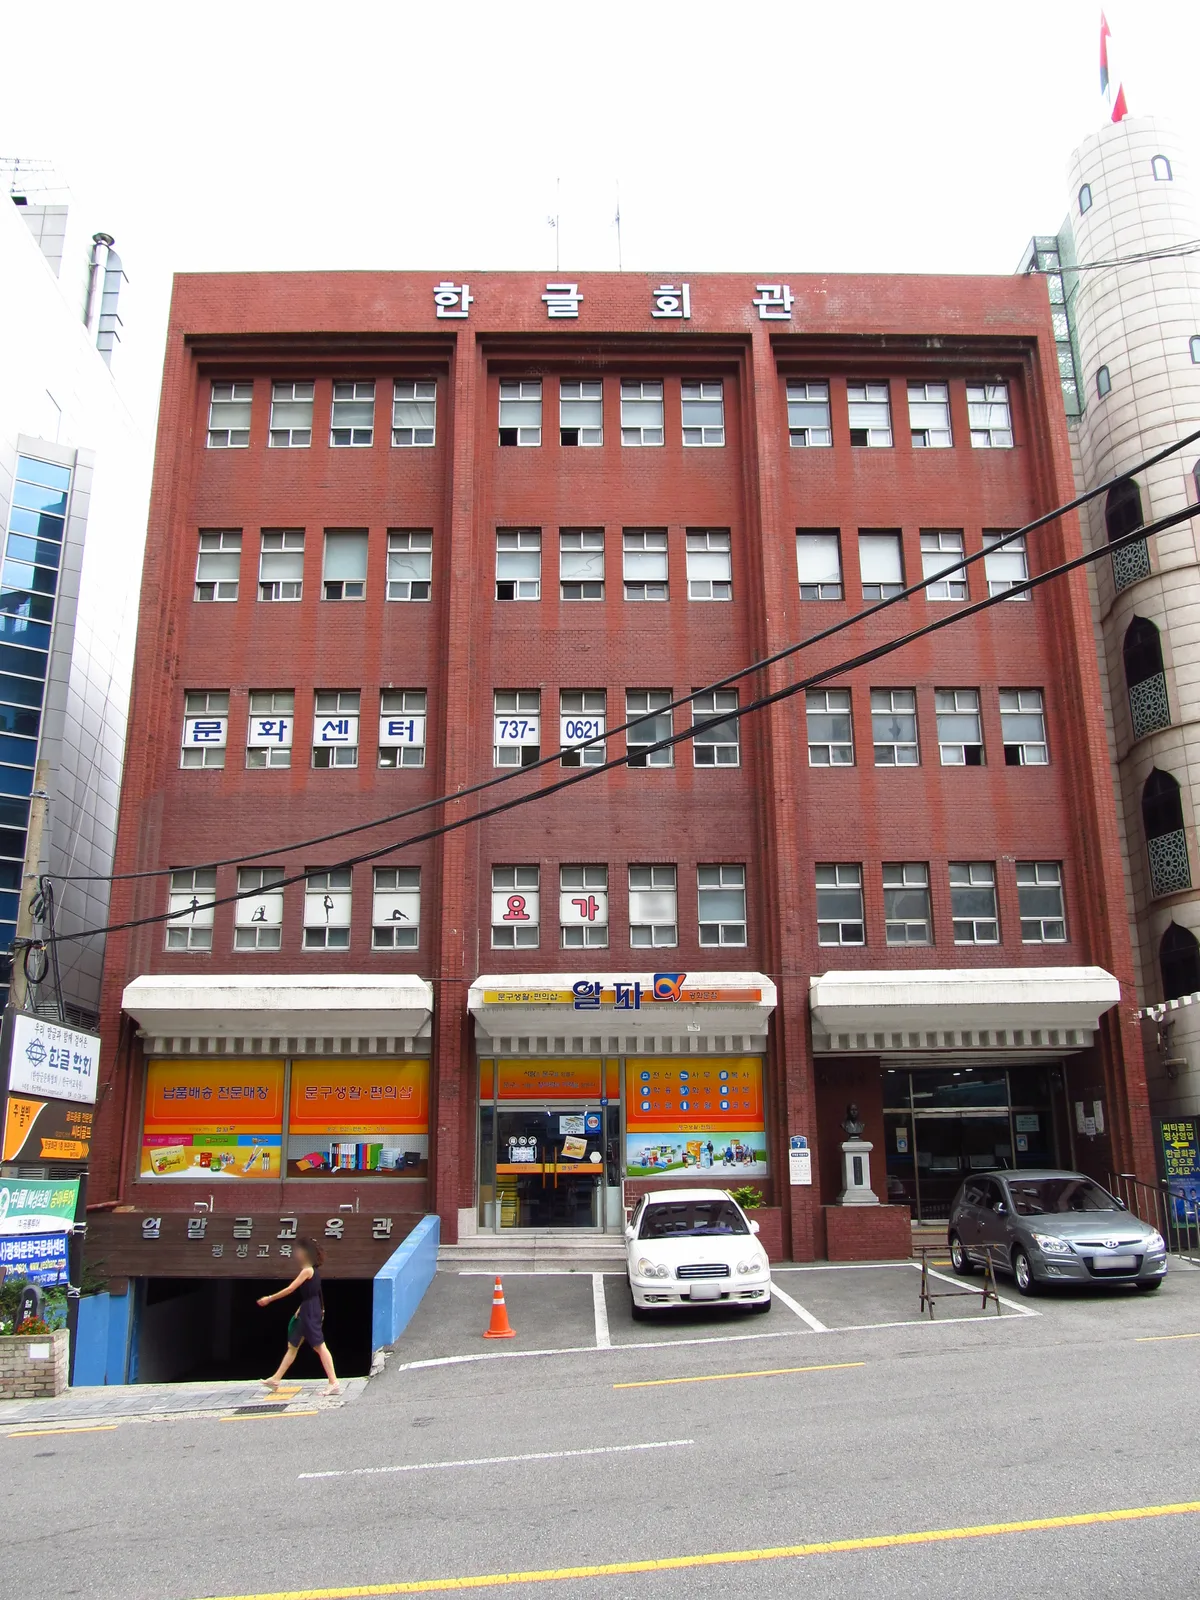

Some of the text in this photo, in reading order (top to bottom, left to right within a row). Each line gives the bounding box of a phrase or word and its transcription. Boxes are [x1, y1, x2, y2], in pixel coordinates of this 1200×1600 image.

[572, 980, 644, 1010] 알파
[49, 1045, 92, 1077] 한글 학회
[163, 1086, 269, 1100] 납품배송 전문매장
[305, 1085, 413, 1100] 문구생활·편의샵
[1162, 1123, 1194, 1132] 씨티골프
[1163, 1132, 1195, 1141] 정상영업
[1165, 1149, 1197, 1158] 한글회관
[1167, 1158, 1195, 1167] 1층으로
